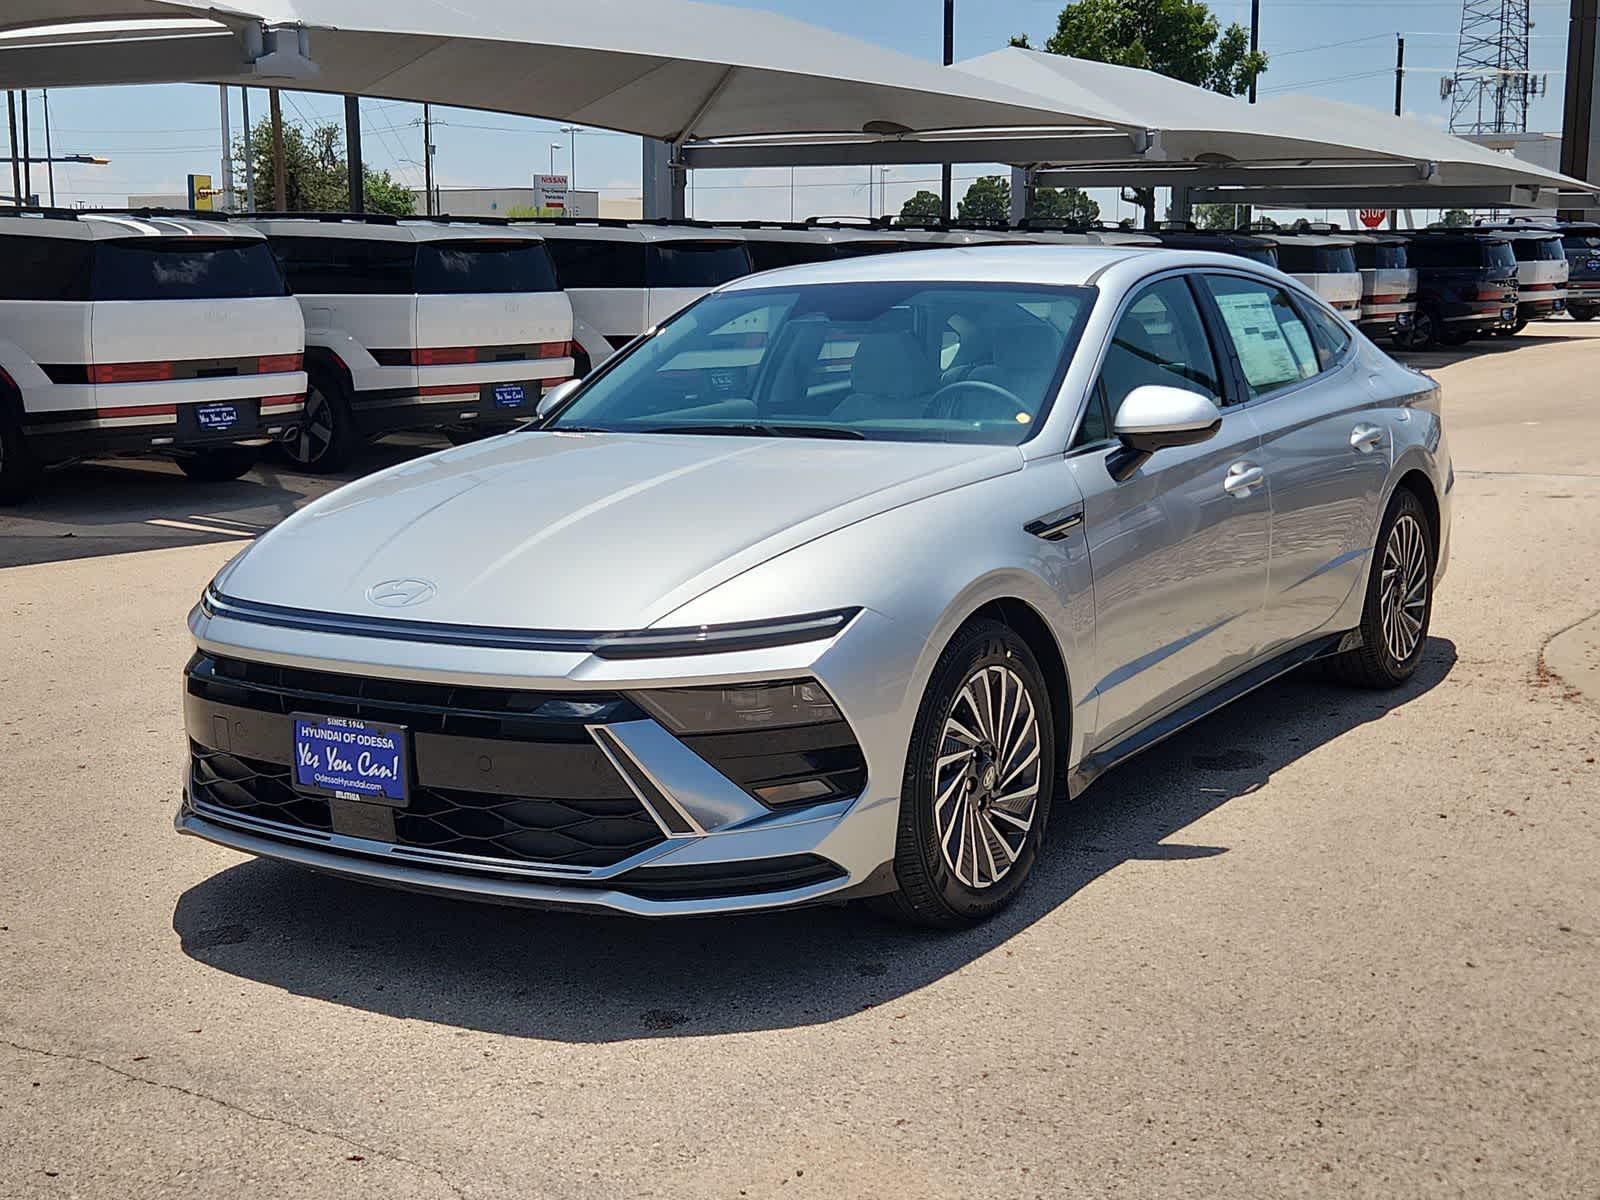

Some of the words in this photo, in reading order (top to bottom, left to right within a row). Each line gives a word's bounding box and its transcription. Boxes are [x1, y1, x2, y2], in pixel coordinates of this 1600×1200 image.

[541, 176, 567, 184] NISSAN
[1360, 208, 1385, 219] STOP
[327, 717, 348, 728] SINCE
[301, 726, 342, 742] HYUNDAI
[342, 732, 356, 744] OF
[356, 734, 395, 749] ODESSA
[298, 742, 320, 768] Yes
[326, 746, 353, 772] You
[357, 751, 399, 781] Can!
[313, 772, 382, 790] OdessaHyundai.com
